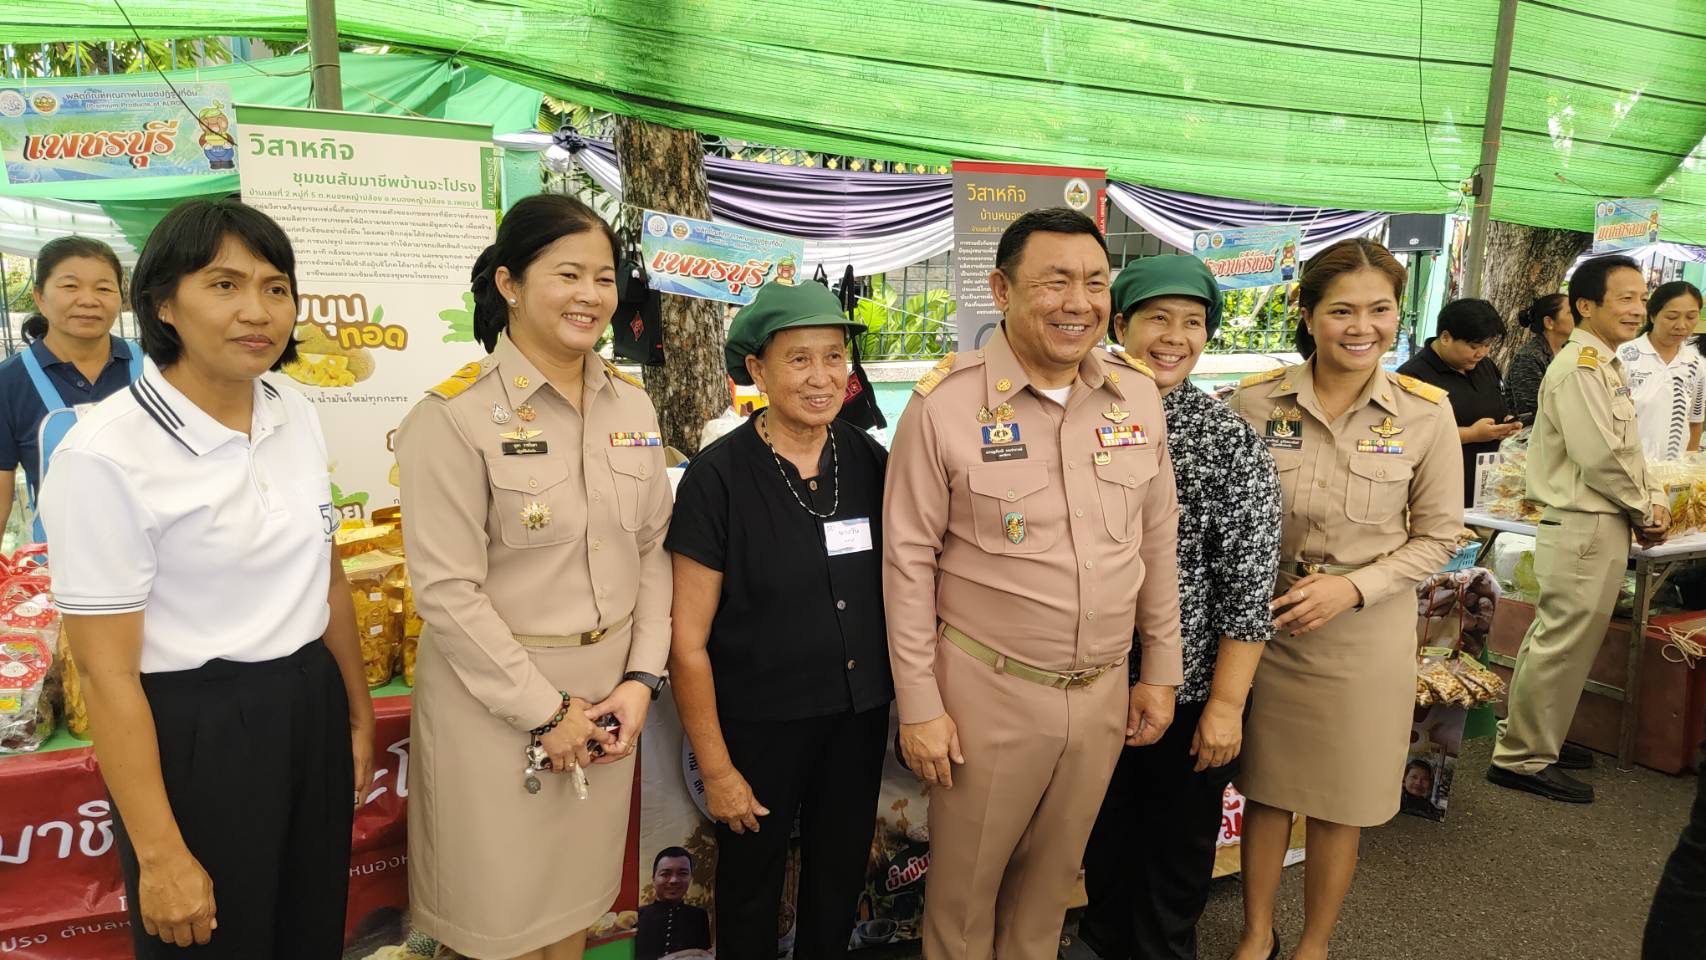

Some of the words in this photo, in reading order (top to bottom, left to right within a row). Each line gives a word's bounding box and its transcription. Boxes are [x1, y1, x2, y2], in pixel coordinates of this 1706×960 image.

[25, 120, 178, 168] เพชรบุรี
[248, 132, 355, 161] วิสาหกิจ
[293, 170, 477, 193] ชุมชนสัมมาชีพบ้านจะโปรง
[966, 183, 1027, 203] วิสาหกิจ
[652, 249, 771, 295] เพชรบุรี
[339, 325, 407, 349] ทอด
